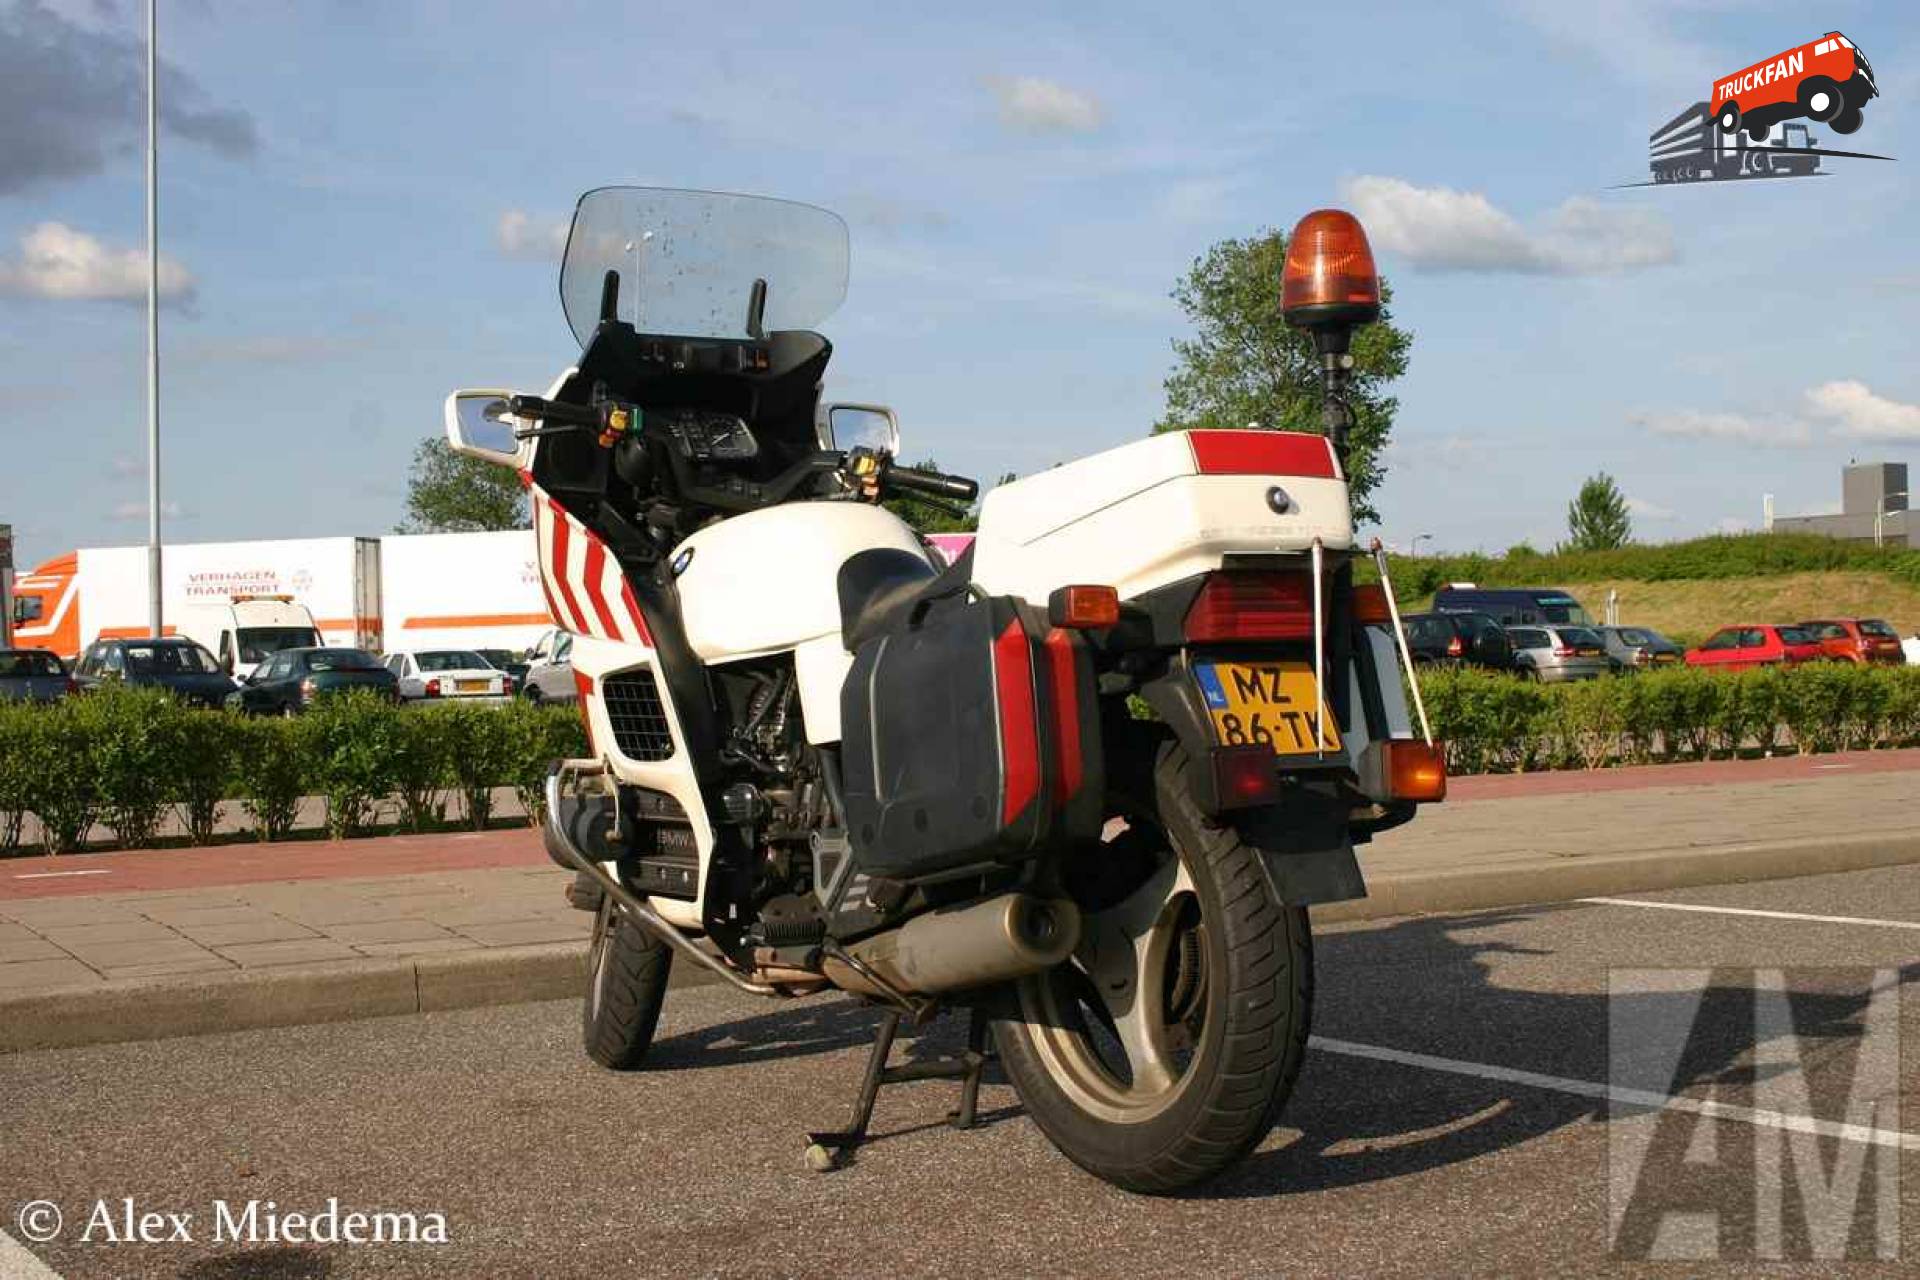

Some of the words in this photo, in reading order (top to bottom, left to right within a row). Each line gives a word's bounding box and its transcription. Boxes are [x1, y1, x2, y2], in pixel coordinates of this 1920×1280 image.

[188, 571, 277, 583] VERHAGEN
[186, 584, 280, 596] TRANSPORT
[1231, 667, 1291, 705] MZ
